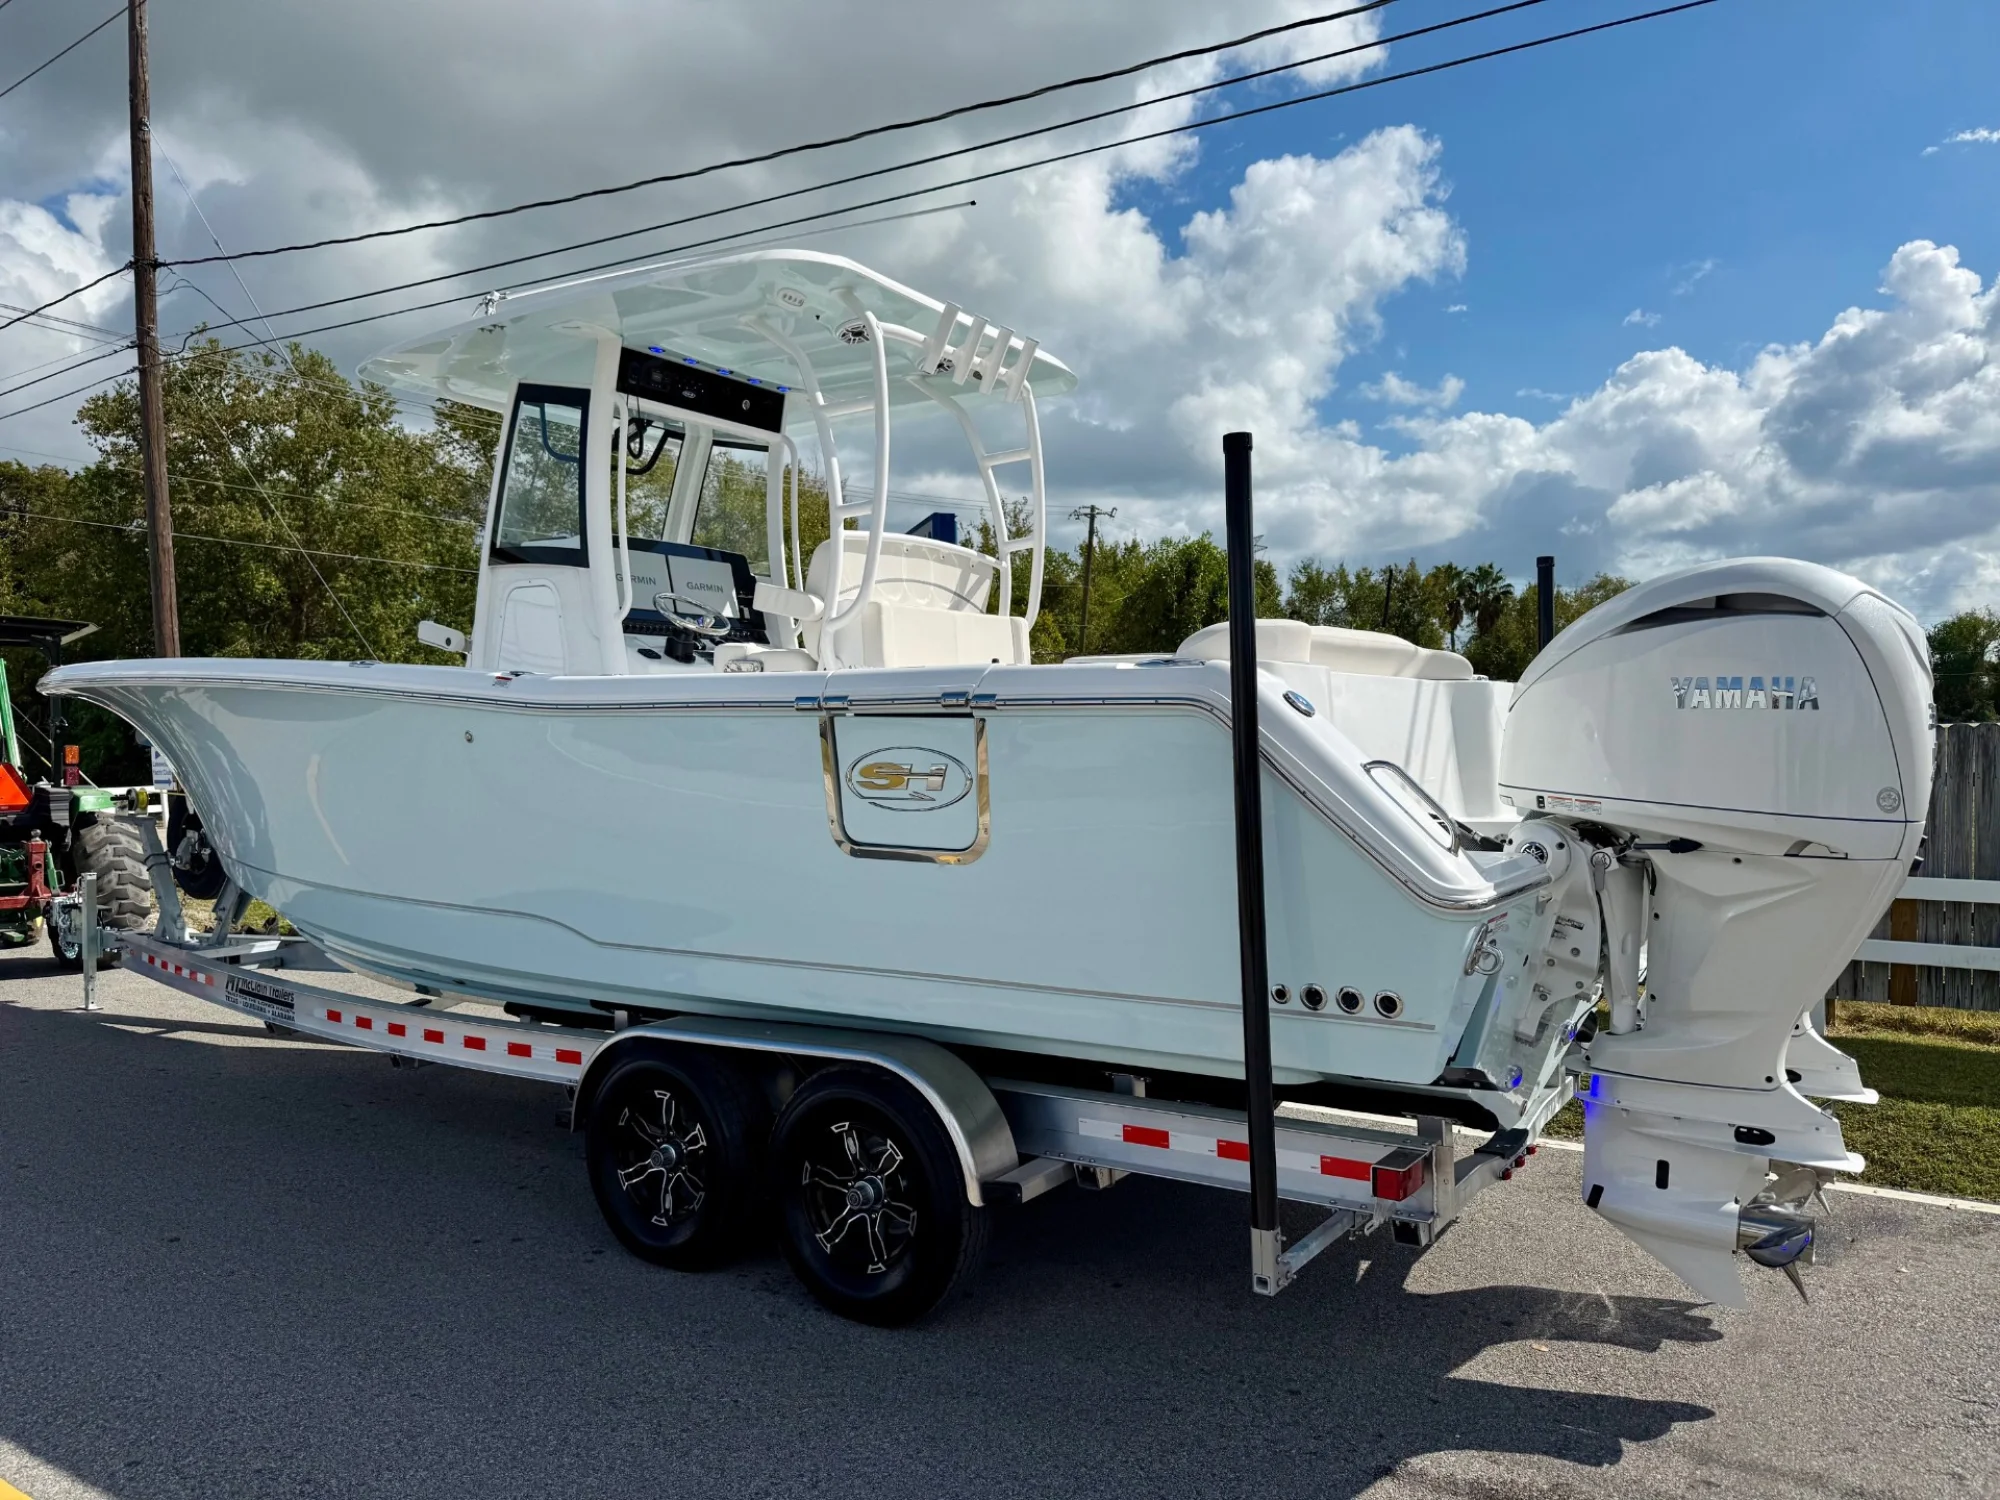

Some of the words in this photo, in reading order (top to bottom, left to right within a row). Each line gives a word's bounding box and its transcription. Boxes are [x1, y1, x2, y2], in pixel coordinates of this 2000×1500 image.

[615, 573, 656, 585] GRMIN
[686, 581, 724, 593] GARMIN
[1670, 676, 1820, 710] YAMAHA
[241, 978, 267, 994] McClain
[269, 985, 295, 1002] Trailers
[225, 994, 239, 1005] TEXAS
